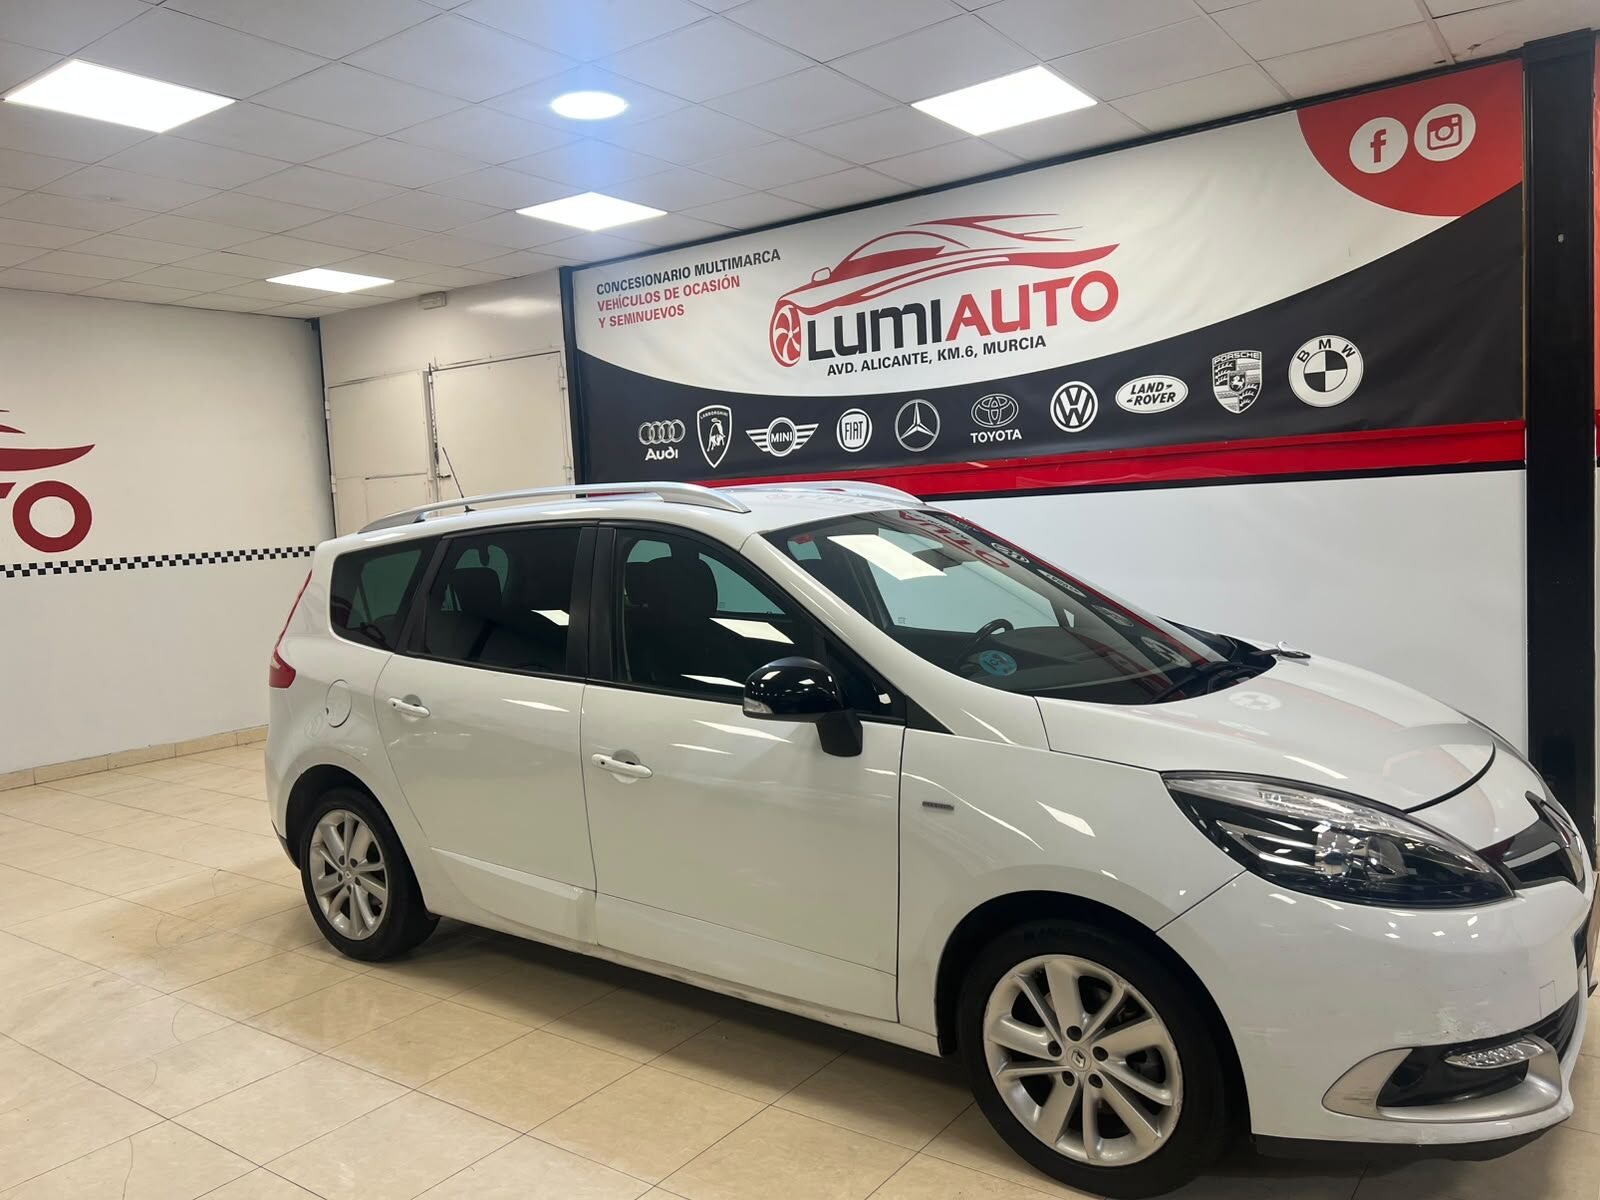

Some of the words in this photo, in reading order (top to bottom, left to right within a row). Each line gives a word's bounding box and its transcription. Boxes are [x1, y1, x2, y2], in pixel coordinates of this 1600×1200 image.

[596, 266, 691, 295] CONCESIONARIO
[694, 248, 781, 277] MULTIMARCA
[597, 290, 660, 312] VEHÍCULOS
[664, 285, 680, 300] DE
[683, 274, 740, 297] OCASIÓN
[598, 317, 605, 328] Y
[609, 304, 685, 327] SEMINUEVOS
[827, 361, 857, 376] AVD.
[860, 351, 933, 372] ALICANTE,
[937, 345, 979, 363] KM.6,
[982, 335, 1047, 355] MURCIA
[1213, 352, 1261, 364] PORSCHE
[1297, 338, 1356, 363] BMW
[770, 431, 793, 443] MINI
[844, 420, 864, 441] FIAT
[970, 428, 1022, 444] TOYOTA
[645, 447, 679, 461] Audi
